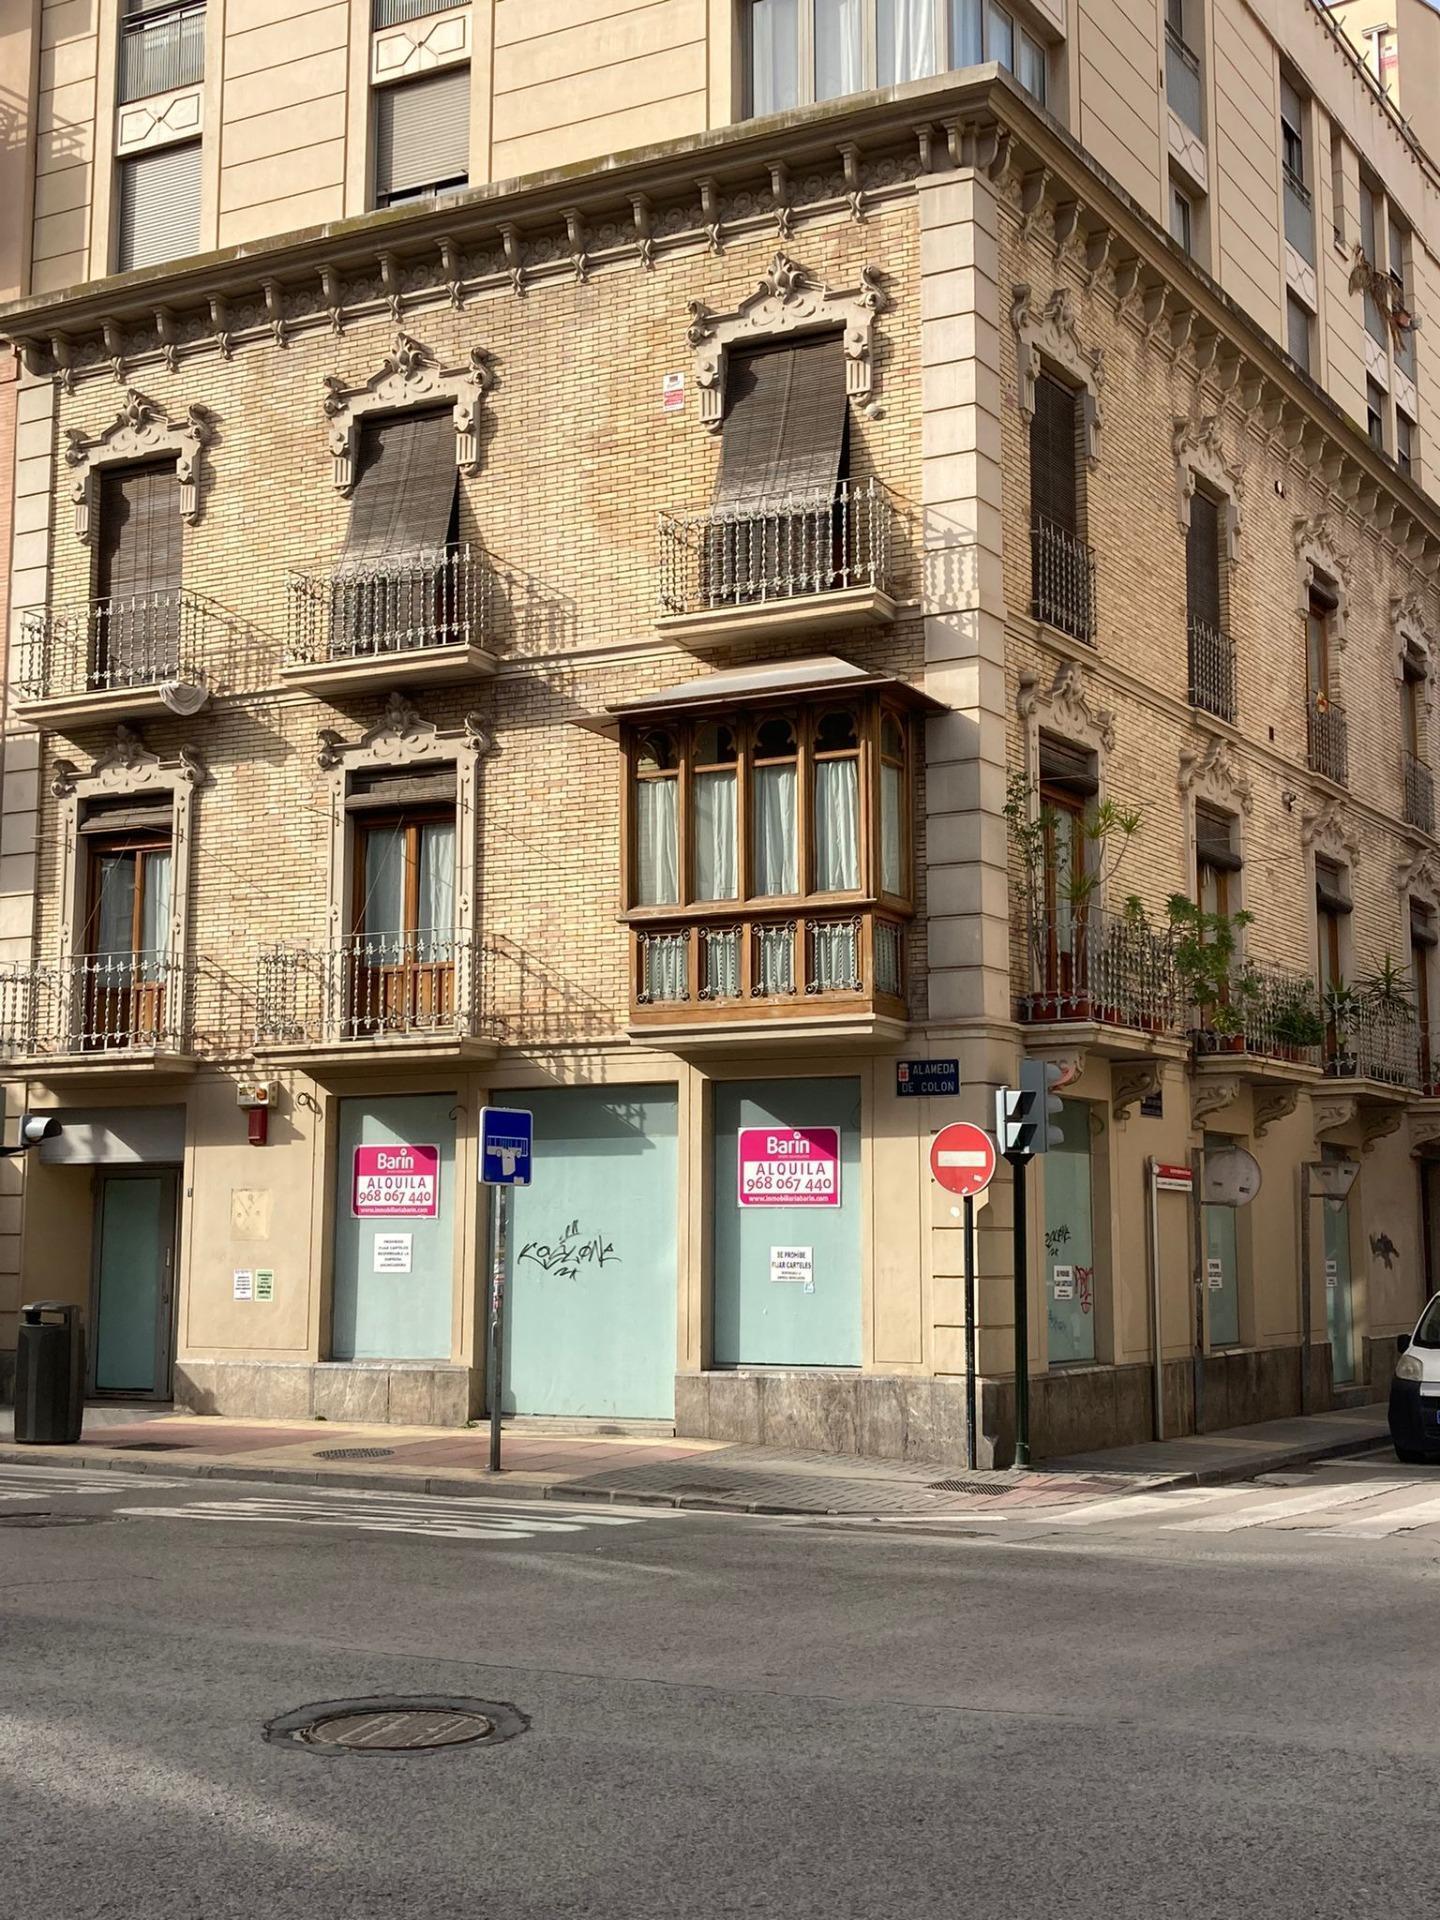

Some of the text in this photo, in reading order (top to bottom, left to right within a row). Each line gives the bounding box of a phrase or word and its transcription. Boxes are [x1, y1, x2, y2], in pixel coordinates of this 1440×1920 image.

[912, 1063, 955, 1075] ALAMEDA
[901, 1082, 914, 1093] DE
[767, 1131, 810, 1154] Barin
[377, 1148, 414, 1169] Barin
[756, 1162, 826, 1176] ALQUILA
[367, 1177, 426, 1189] ALQUILA
[747, 1176, 832, 1192] 968 067 440
[359, 1190, 431, 1204] 968 067 440
